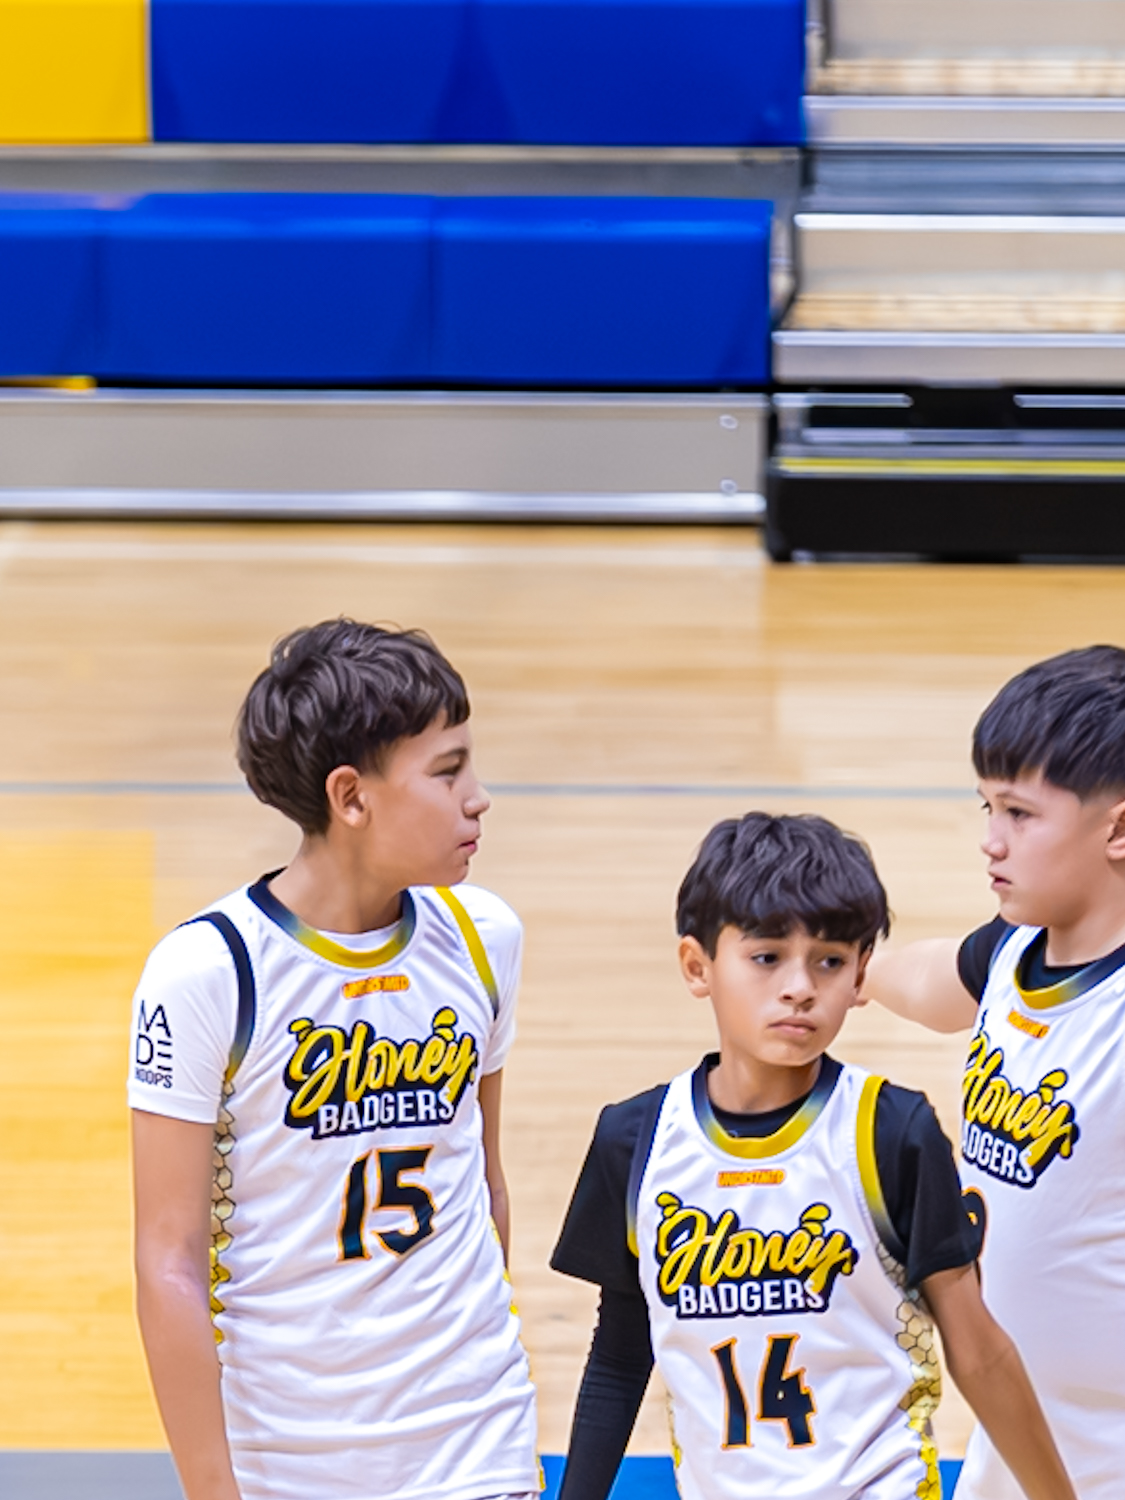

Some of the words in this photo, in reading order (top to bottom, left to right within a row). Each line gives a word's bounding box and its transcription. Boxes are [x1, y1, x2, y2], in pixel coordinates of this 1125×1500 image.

[285, 1012, 478, 1120] Honey
[318, 1088, 455, 1135] BADGERS
[962, 1123, 1033, 1183] DGERS
[338, 1145, 436, 1262] 15
[656, 1202, 857, 1297] Honey
[678, 1278, 825, 1315] BADGERS
[710, 1334, 816, 1450] 14
